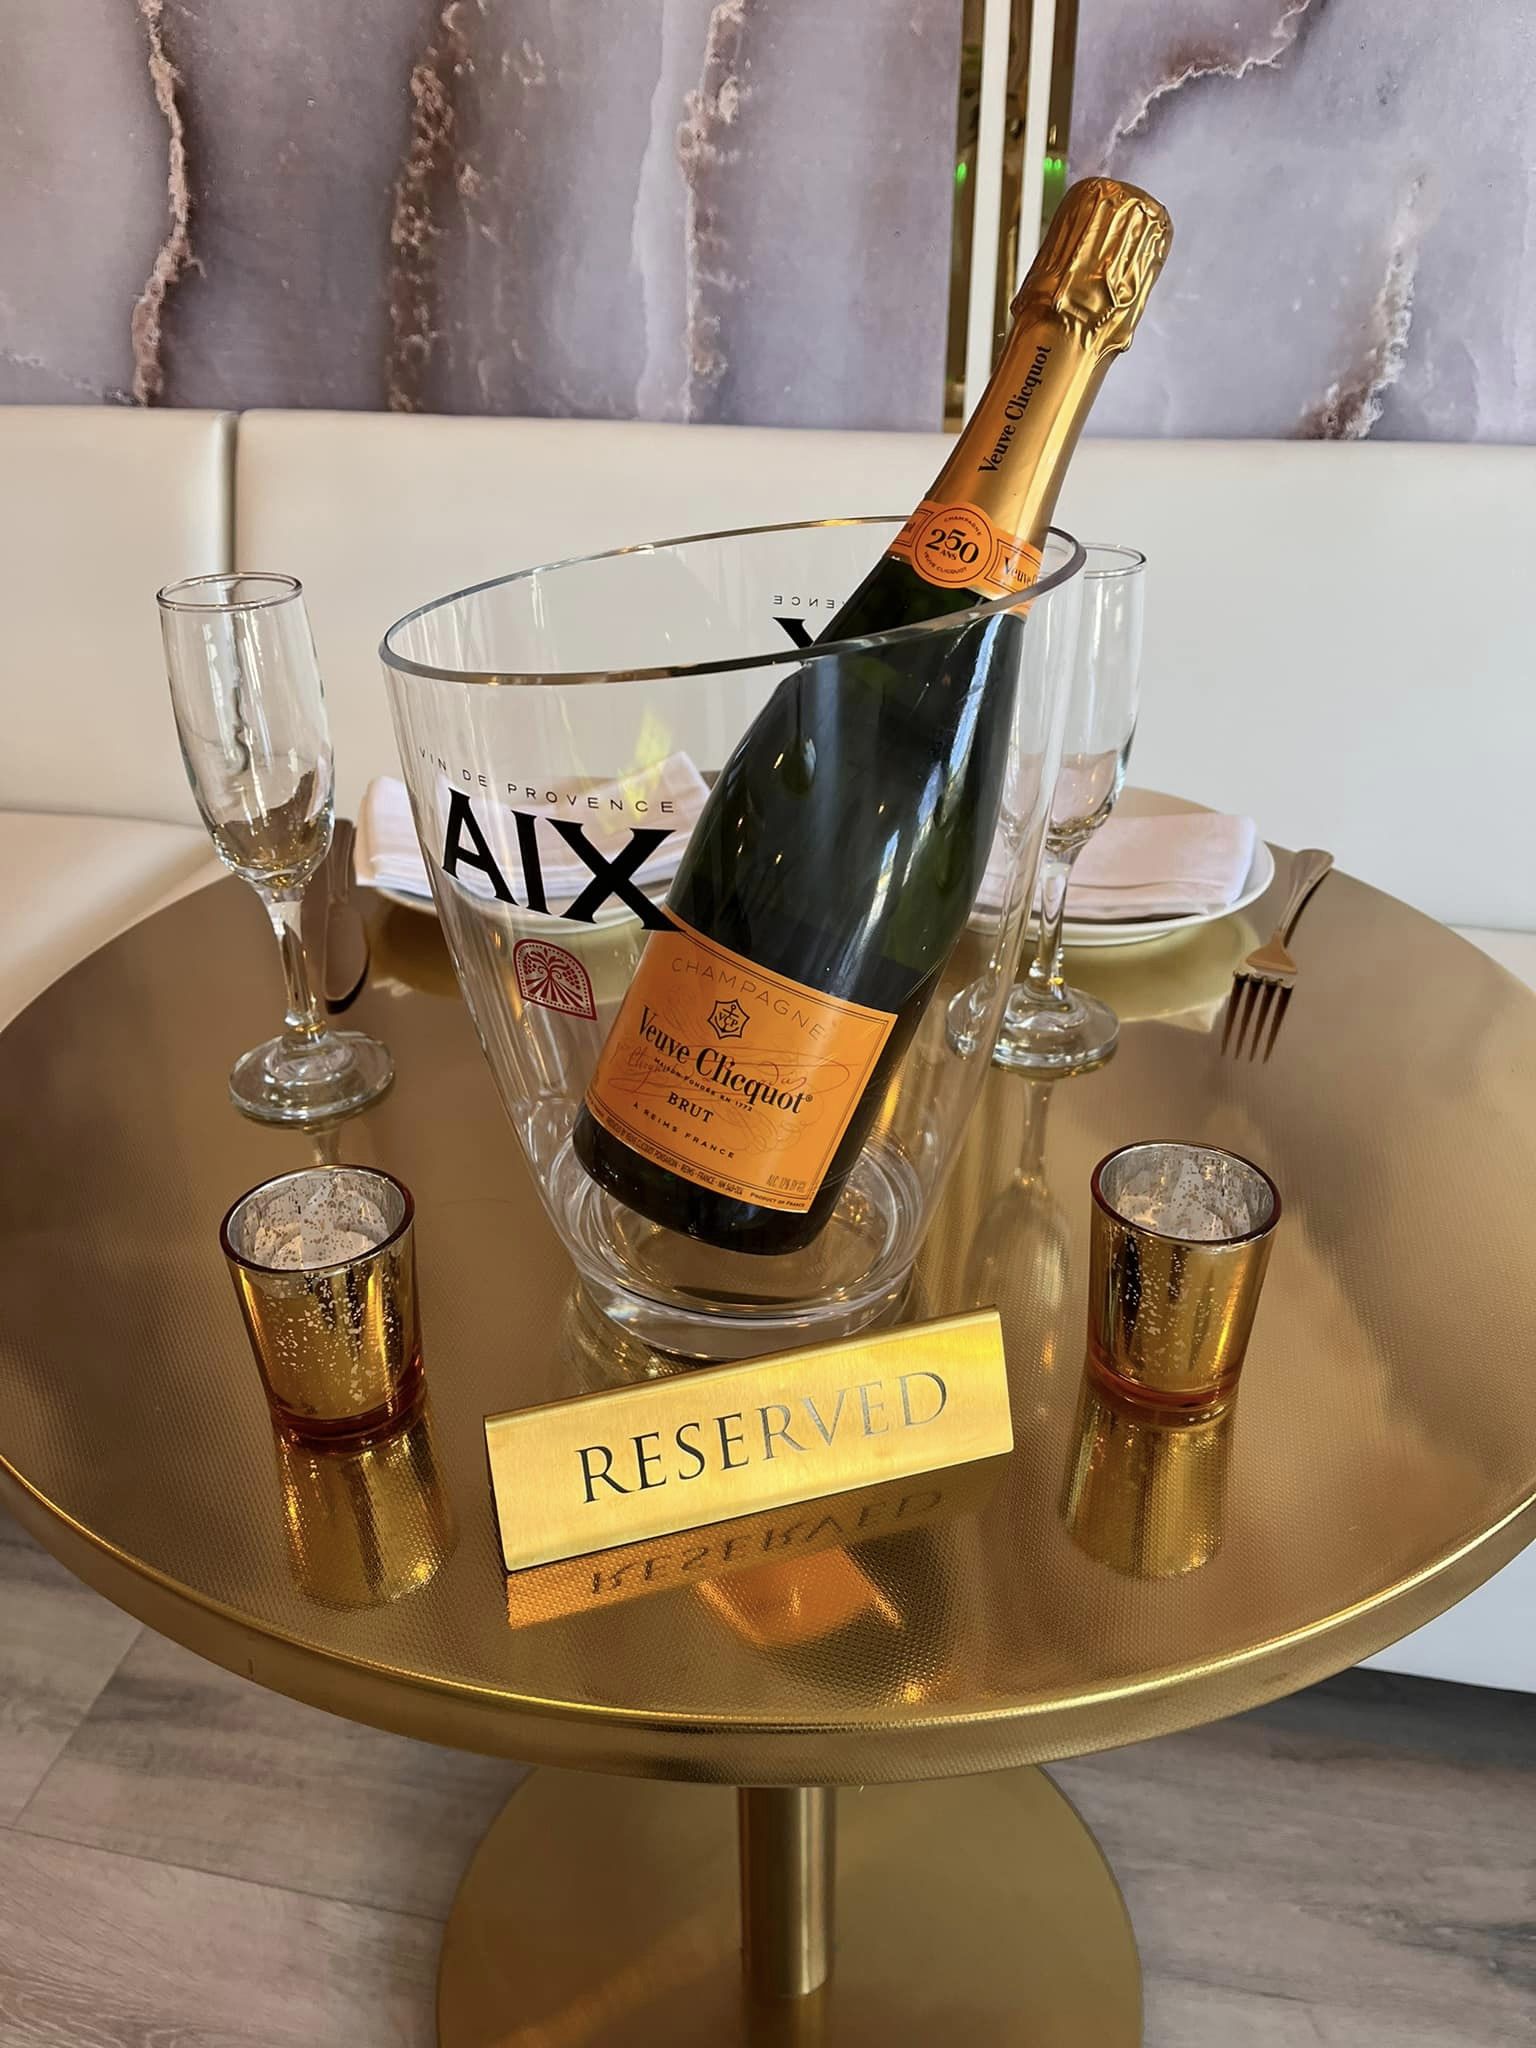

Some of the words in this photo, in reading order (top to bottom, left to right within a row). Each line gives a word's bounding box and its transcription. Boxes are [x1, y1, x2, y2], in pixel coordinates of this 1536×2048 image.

[978, 424, 1015, 473] Veuve
[1005, 345, 1052, 421] Clicquot
[925, 528, 979, 564] 250
[420, 747, 447, 770] VIN
[462, 769, 487, 787] DE
[507, 783, 674, 813] PROVENCE
[442, 787, 688, 932] AIX
[671, 957, 826, 1041] CHAMPAGNE
[640, 1004, 691, 1064] Veuve
[643, 1108, 678, 1133] REIMS
[684, 1132, 735, 1159] FRANCE
[667, 1091, 714, 1123] BRUT
[735, 1101, 753, 1112] 1772
[575, 1371, 947, 1505] RESERVED
